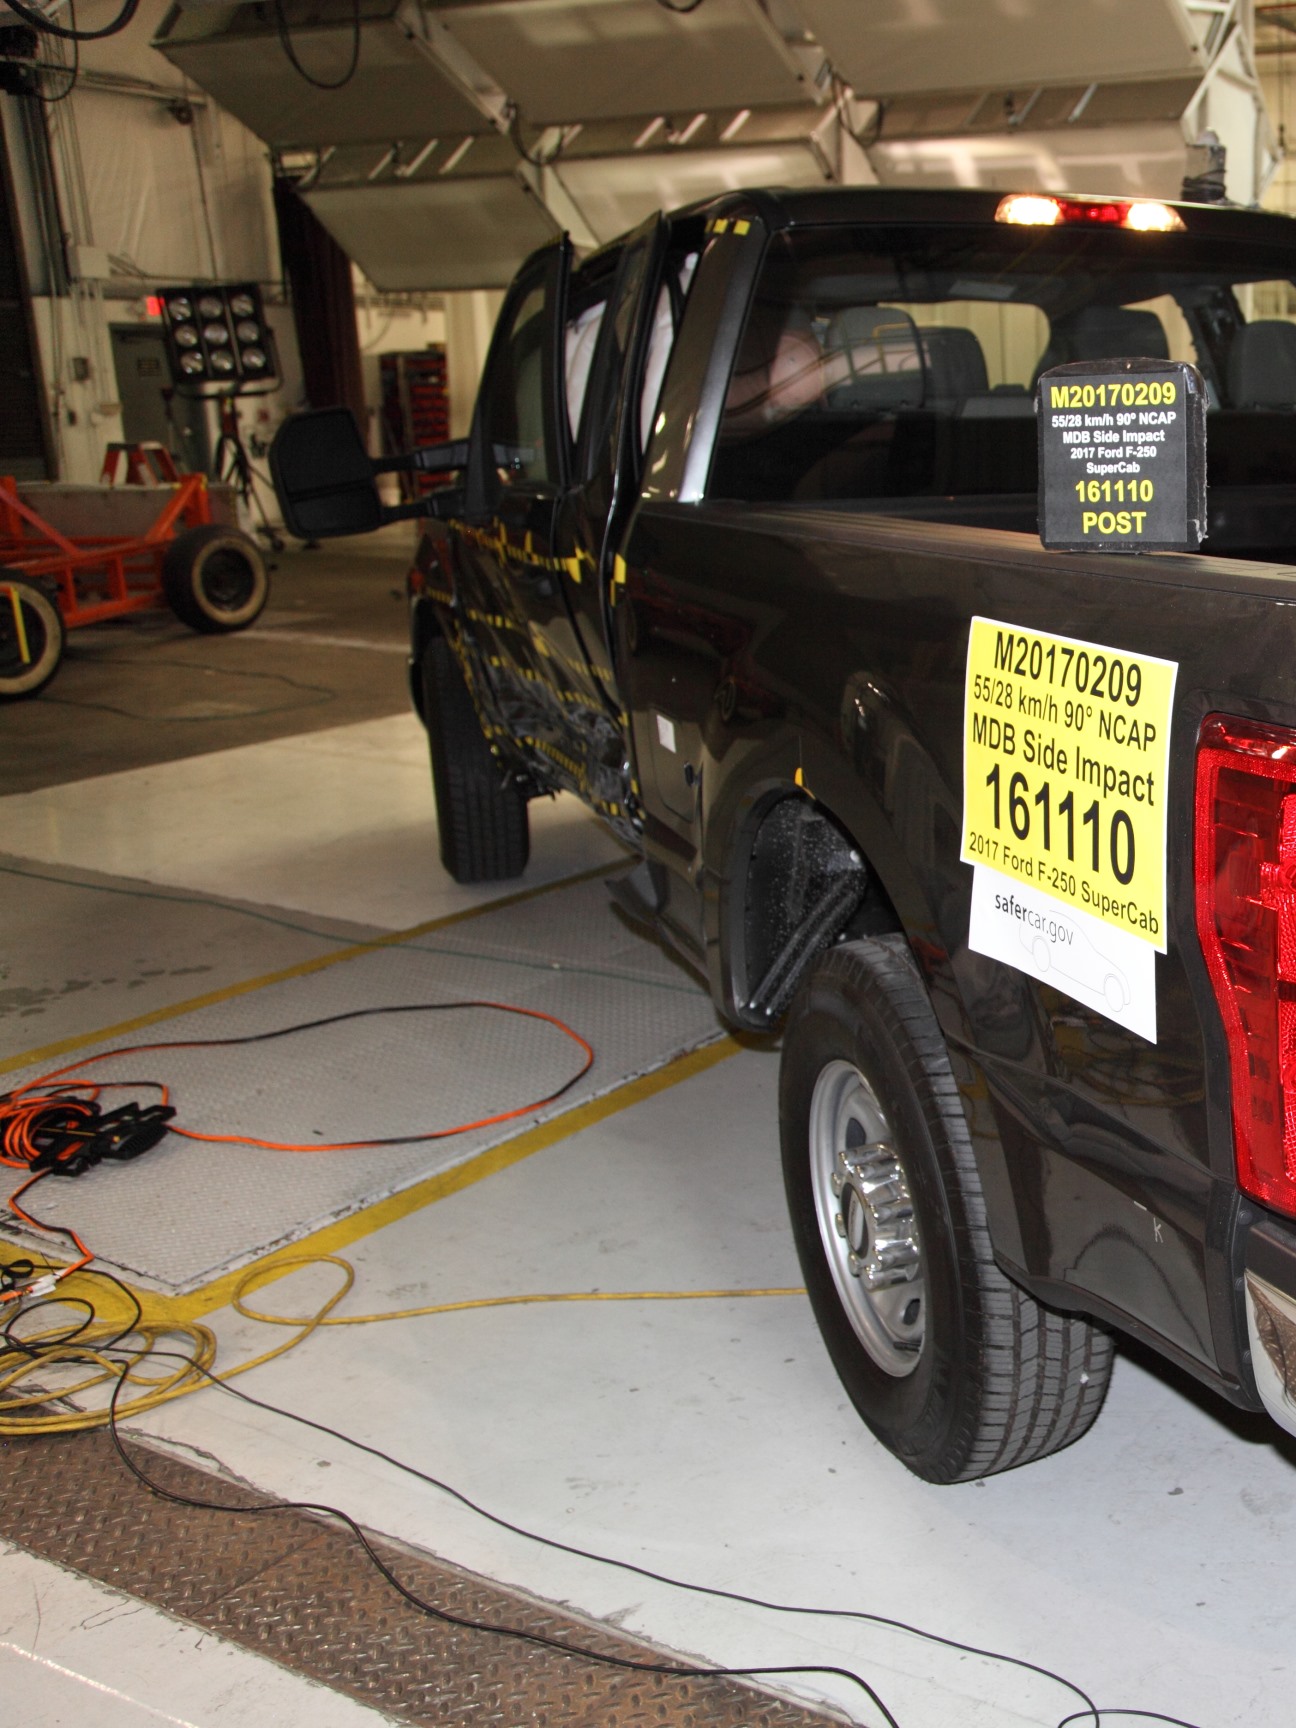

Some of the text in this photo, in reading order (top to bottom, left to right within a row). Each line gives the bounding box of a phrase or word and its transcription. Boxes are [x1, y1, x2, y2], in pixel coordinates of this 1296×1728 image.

[1050, 381, 1176, 409] M20170209
[1051, 414, 1082, 428] 55/28
[1084, 413, 1114, 427] km/h
[1139, 411, 1177, 426] NCAP
[1062, 429, 1165, 445] MDB Side Impact
[1070, 446, 1157, 460] 2017 Ford F-250
[1086, 461, 1140, 476] SuperCab
[1075, 480, 1154, 503] 161110
[1082, 511, 1147, 535] POST
[994, 631, 1142, 707] M20170209
[973, 674, 1013, 709] 55/28
[1018, 687, 1058, 723] km/h
[1099, 709, 1156, 752] NCAP
[973, 712, 1154, 807] MDB Side Impact
[986, 763, 1136, 886] 161110
[969, 831, 1159, 935] 2017 Ford F-250 SuperCab
[995, 894, 1074, 946] safercar.gov
